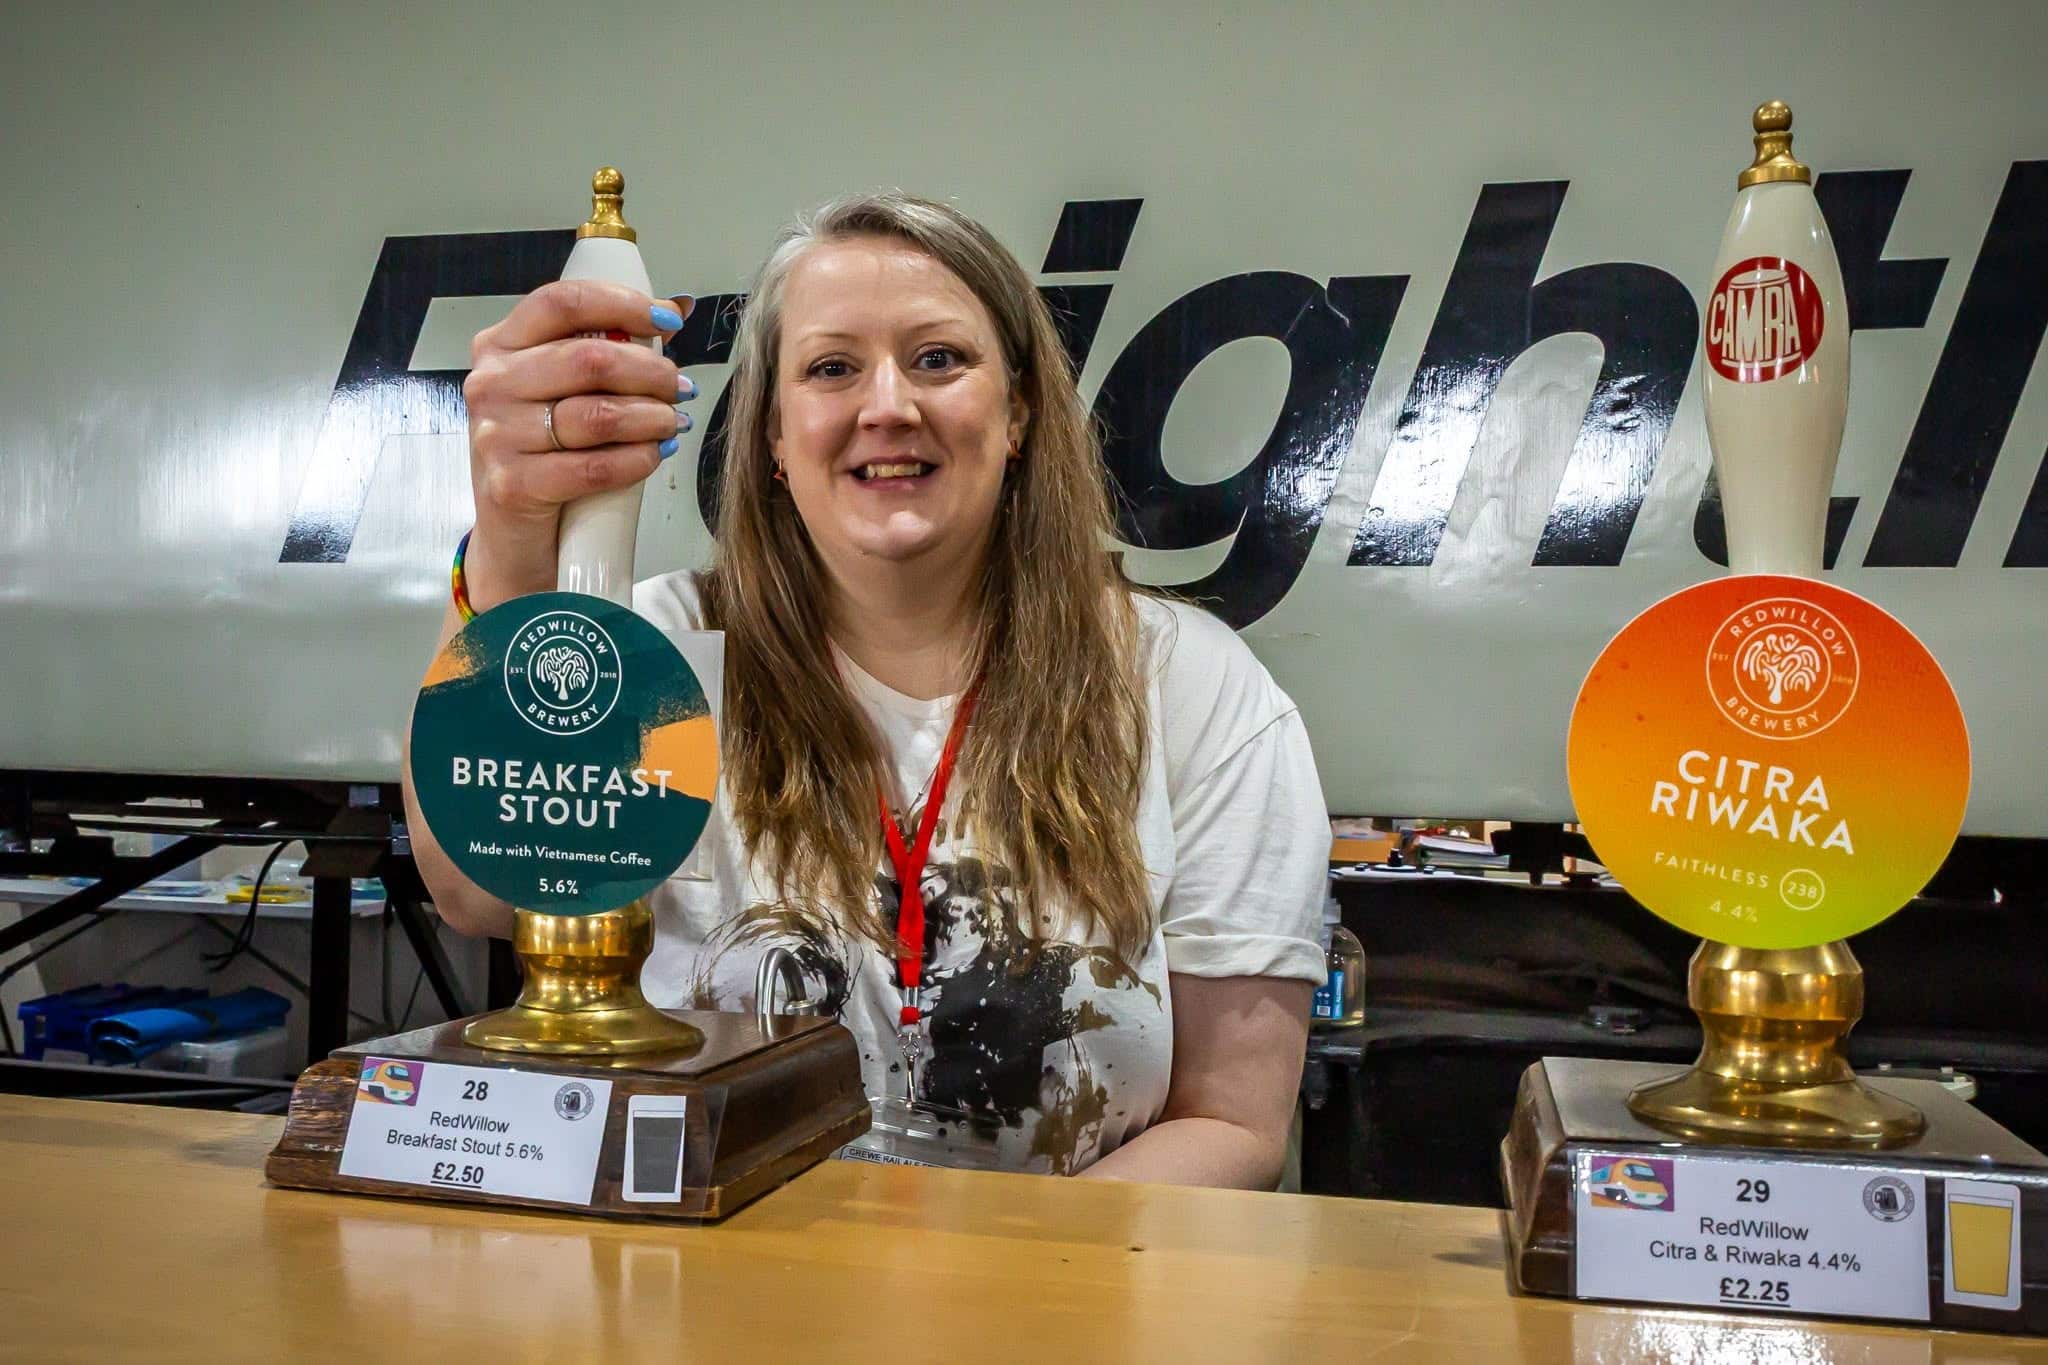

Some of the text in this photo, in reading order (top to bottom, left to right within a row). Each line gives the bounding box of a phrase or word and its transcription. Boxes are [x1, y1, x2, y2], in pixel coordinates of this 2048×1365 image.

[1710, 281, 1801, 362] CAMRA
[520, 620, 608, 653] REDWILLOW
[1730, 607, 1847, 656] REDWILLOW
[527, 703, 599, 726] BREWERY
[1726, 696, 1820, 731] BREWERY
[453, 757, 672, 798] BREAKFAST
[1677, 750, 1830, 811] CITRA
[499, 794, 622, 829] STOUT
[1650, 781, 1855, 855] RIWAKA
[469, 841, 652, 866] Made with Vietnamese Coffee
[538, 878, 579, 895] 5.6%
[1654, 851, 1818, 900] FAITHLESS 238
[1709, 899, 1758, 923] 4.4%
[462, 1079, 489, 1101] 28
[430, 1110, 510, 1134] RedWillow
[387, 1128, 544, 1161] Breakfast Stout 5.6%
[431, 1161, 485, 1187] £2.50
[1735, 1178, 1771, 1203] 29
[1700, 1216, 1809, 1242] RedWillow
[1649, 1240, 1862, 1273] Citra & Riwaka 4.4%
[1719, 1276, 1791, 1304] £2.25
